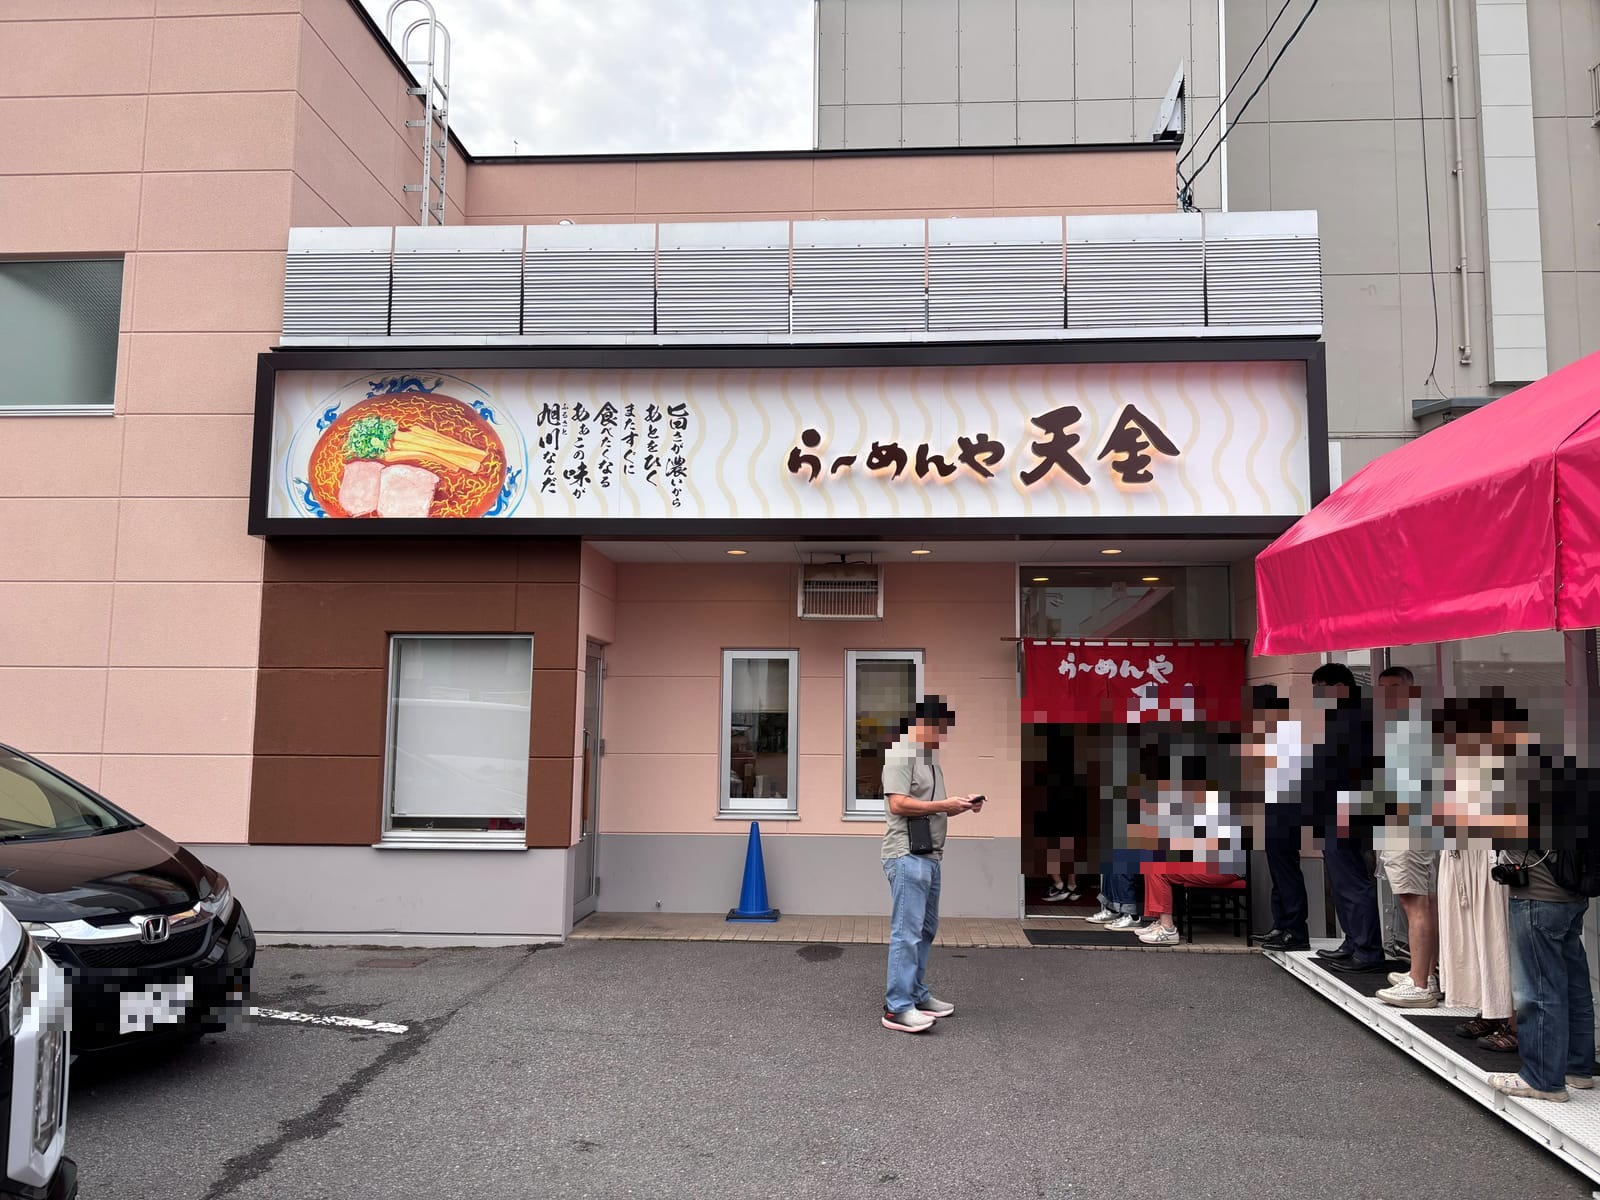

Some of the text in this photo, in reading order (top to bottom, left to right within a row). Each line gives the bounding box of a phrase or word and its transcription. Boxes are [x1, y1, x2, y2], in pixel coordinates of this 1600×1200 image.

[537, 402, 561, 494] 旭川なんだ
[593, 401, 618, 488] 食べたくなる
[620, 403, 639, 475] またすぐに
[644, 403, 662, 487] あとをひく
[665, 403, 689, 508] 旨さが濃いから
[1019, 404, 1180, 486] 天金
